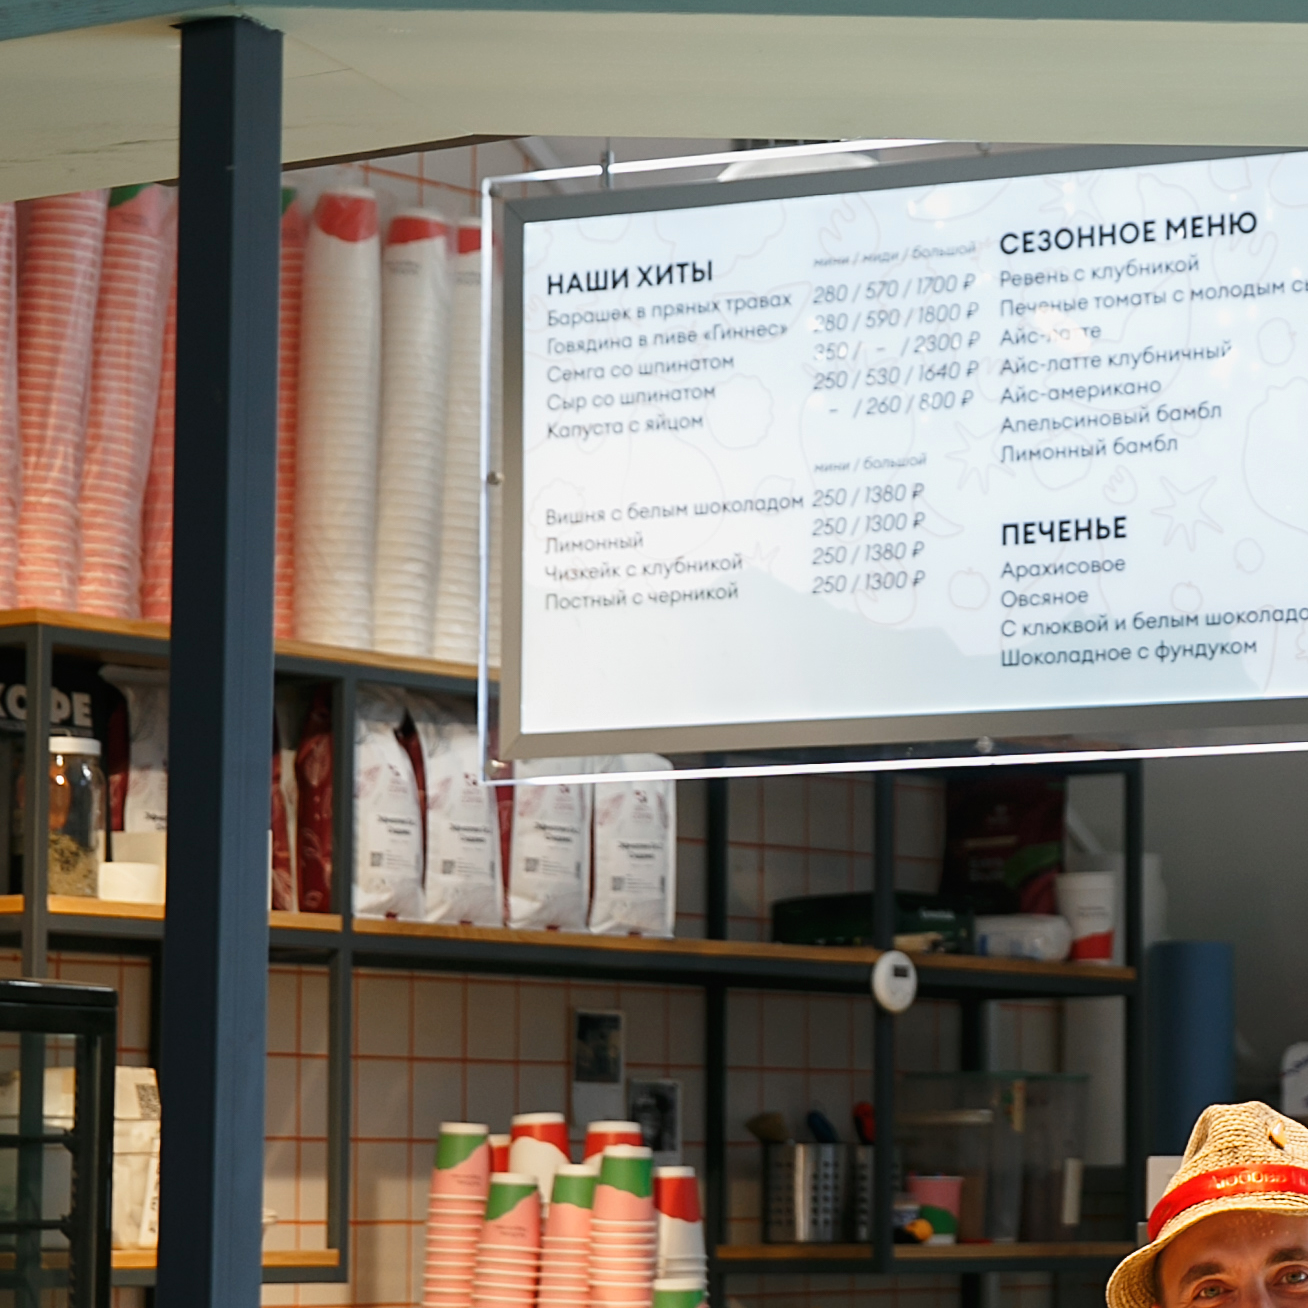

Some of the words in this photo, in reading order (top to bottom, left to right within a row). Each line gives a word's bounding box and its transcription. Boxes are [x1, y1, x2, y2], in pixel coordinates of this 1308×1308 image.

[998, 218, 1157, 257] СЕЗОННОЕ
[1165, 209, 1259, 242] МЕНЮ
[546, 266, 630, 297] НАШИ
[635, 258, 714, 290] ХИТЫ
[999, 270, 1070, 288] Ревень
[1073, 268, 1085, 282] с
[1091, 254, 1200, 284] клубникой
[1093, 291, 1167, 309] томаты
[1172, 289, 1184, 304] с
[1189, 281, 1285, 302] молодым
[546, 307, 632, 330] Барашек
[636, 306, 647, 321] в
[651, 299, 722, 322] пряных
[724, 293, 793, 316] травах
[546, 335, 633, 355] Говядина
[637, 334, 649, 349] в
[652, 329, 699, 346] пиве
[546, 365, 606, 384] Семга
[609, 363, 634, 379] со
[637, 356, 735, 377] шпинатом
[998, 354, 1102, 376] Айс-латте
[1107, 339, 1232, 371] клубничный
[546, 393, 588, 414] Сыр
[591, 393, 615, 408] со
[619, 385, 716, 406] шпинатом
[999, 379, 1162, 405] Айс-американо
[546, 421, 624, 442] Капуста
[627, 419, 640, 434] с
[644, 413, 704, 432] яйцом
[999, 405, 1150, 434] Апельсиновый
[1155, 400, 1222, 423] бамбл
[999, 438, 1107, 464] Лимонный
[1112, 433, 1178, 456] бамбл
[545, 508, 606, 527] Вишня
[610, 508, 623, 522] с
[626, 501, 689, 521] белым
[693, 495, 805, 516] шоколадом
[544, 531, 644, 555] Лимонный
[1001, 514, 1128, 547] ПЕЧЕНЬЕ
[544, 561, 621, 582] Чизкейк
[625, 564, 637, 578] с
[641, 552, 744, 580] клубникой
[1000, 558, 1127, 583] Арахисовое
[545, 589, 628, 611] Постный
[631, 592, 643, 606] с
[647, 581, 739, 608] черникой
[1000, 589, 1089, 609] Овсяное
[1000, 618, 1017, 638] С
[1022, 613, 1109, 637] клюквой
[1114, 618, 1127, 632] и
[1131, 610, 1200, 631] белым
[1000, 646, 1133, 668] Шоколадное
[1136, 645, 1150, 660] с
[1154, 639, 1258, 664] фундуком
